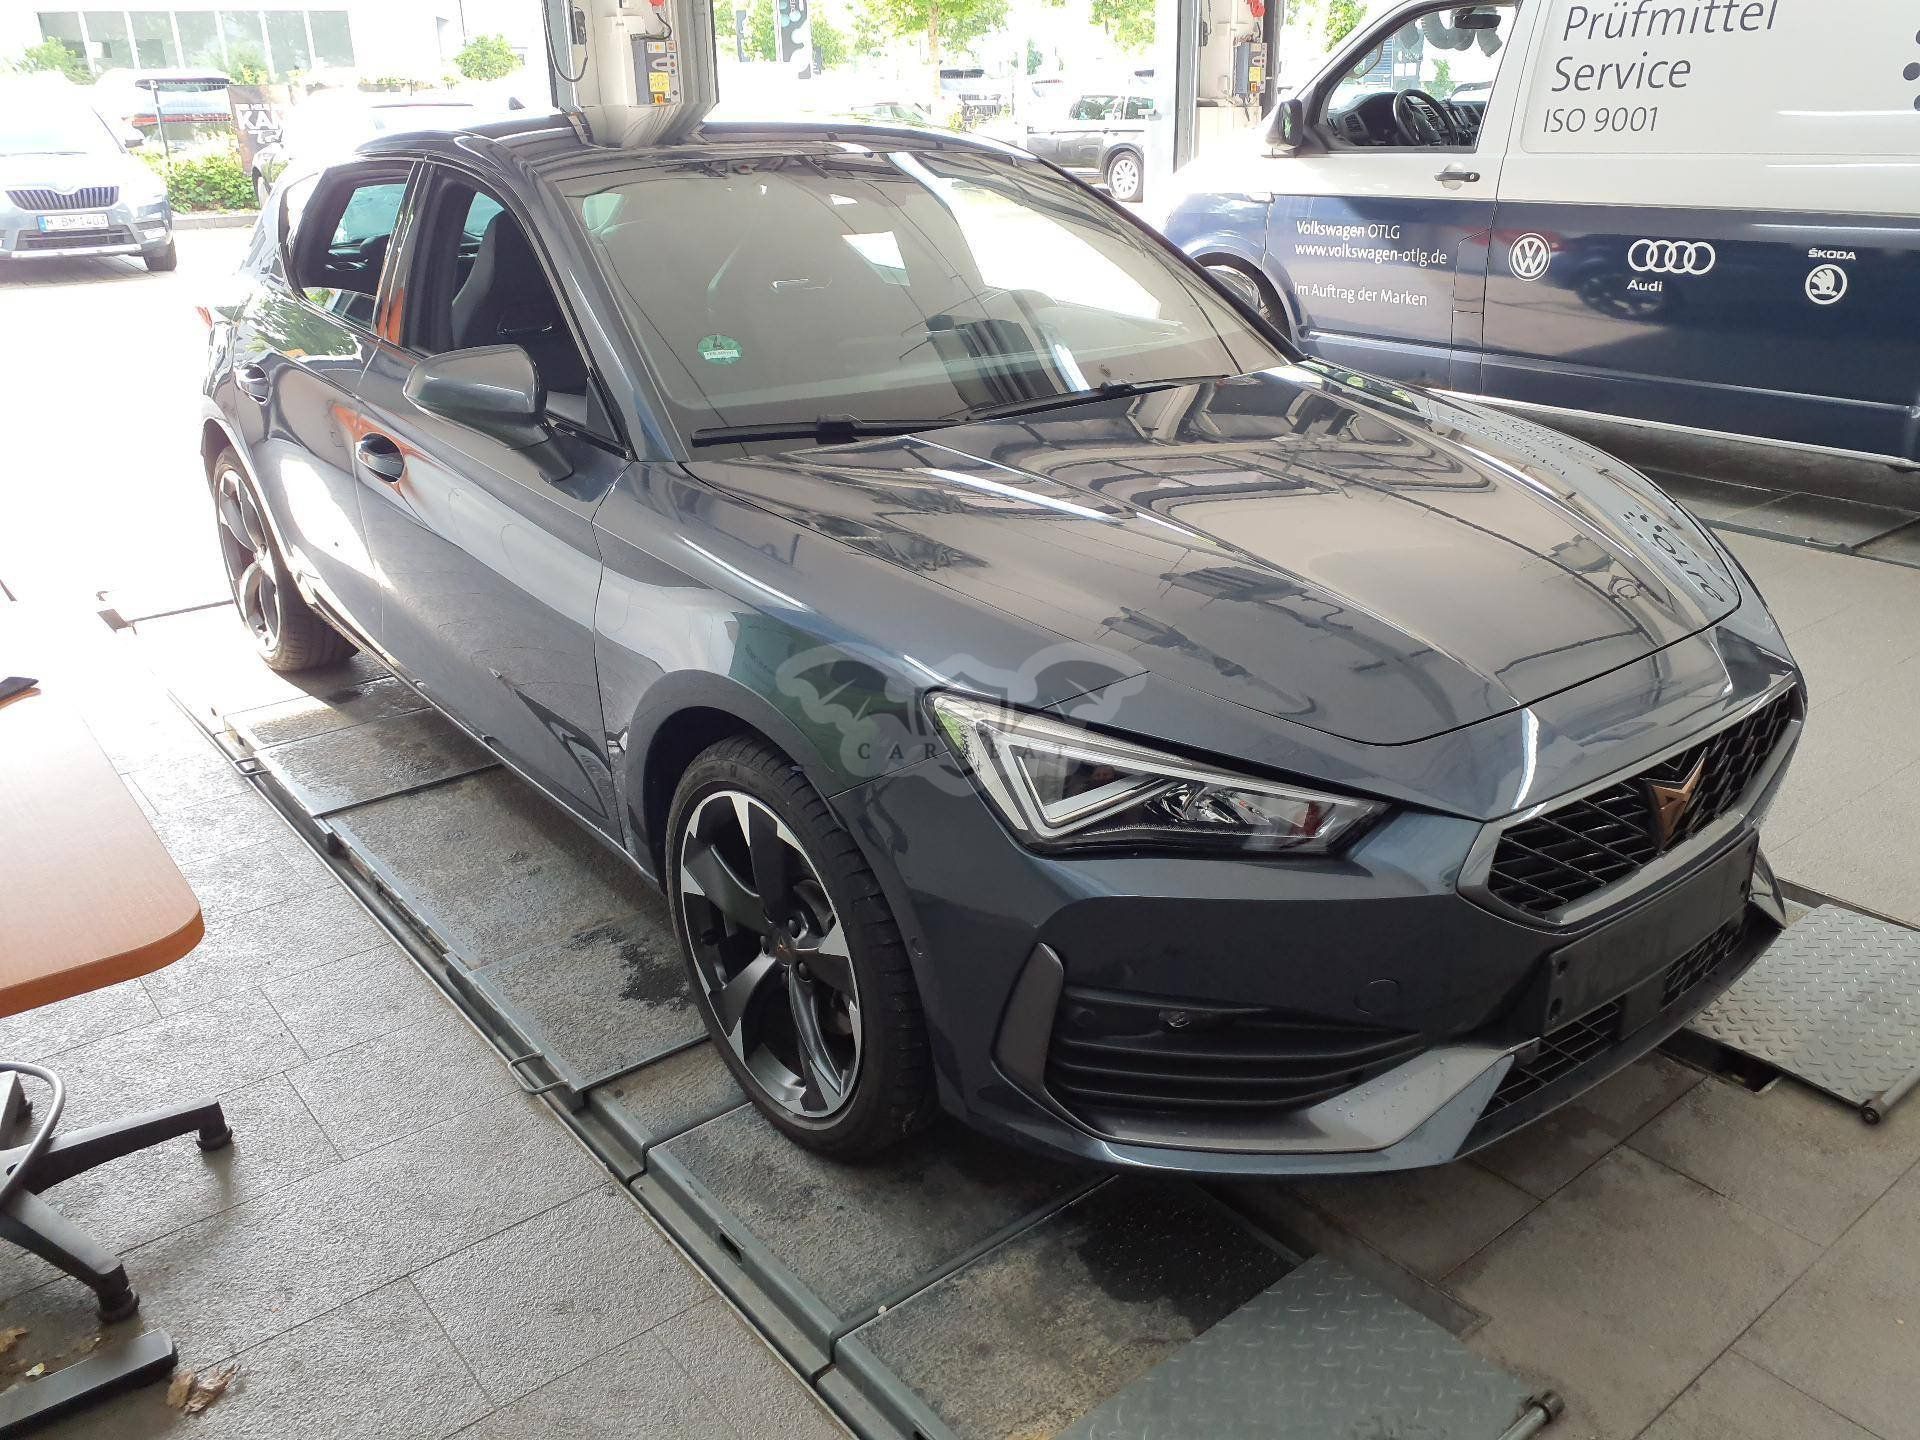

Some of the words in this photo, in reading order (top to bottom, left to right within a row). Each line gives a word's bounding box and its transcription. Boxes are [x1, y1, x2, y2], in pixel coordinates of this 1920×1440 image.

[1563, 0, 1778, 41] Prüfmittel
[1552, 51, 1691, 91] Service
[1544, 108, 1586, 132] ISO
[1594, 106, 1659, 132] 9001
[1296, 220, 1365, 240] Volkswagen
[1368, 224, 1400, 239] OTLG
[1295, 243, 1447, 267] www.volkswagen-otlg.de
[1808, 247, 1856, 260] ŠKODA
[1294, 282, 1309, 295] Im
[1311, 283, 1355, 303] Auftrag
[1357, 286, 1378, 301] der
[1380, 289, 1428, 306] Marken
[1626, 279, 1663, 292] Audi
